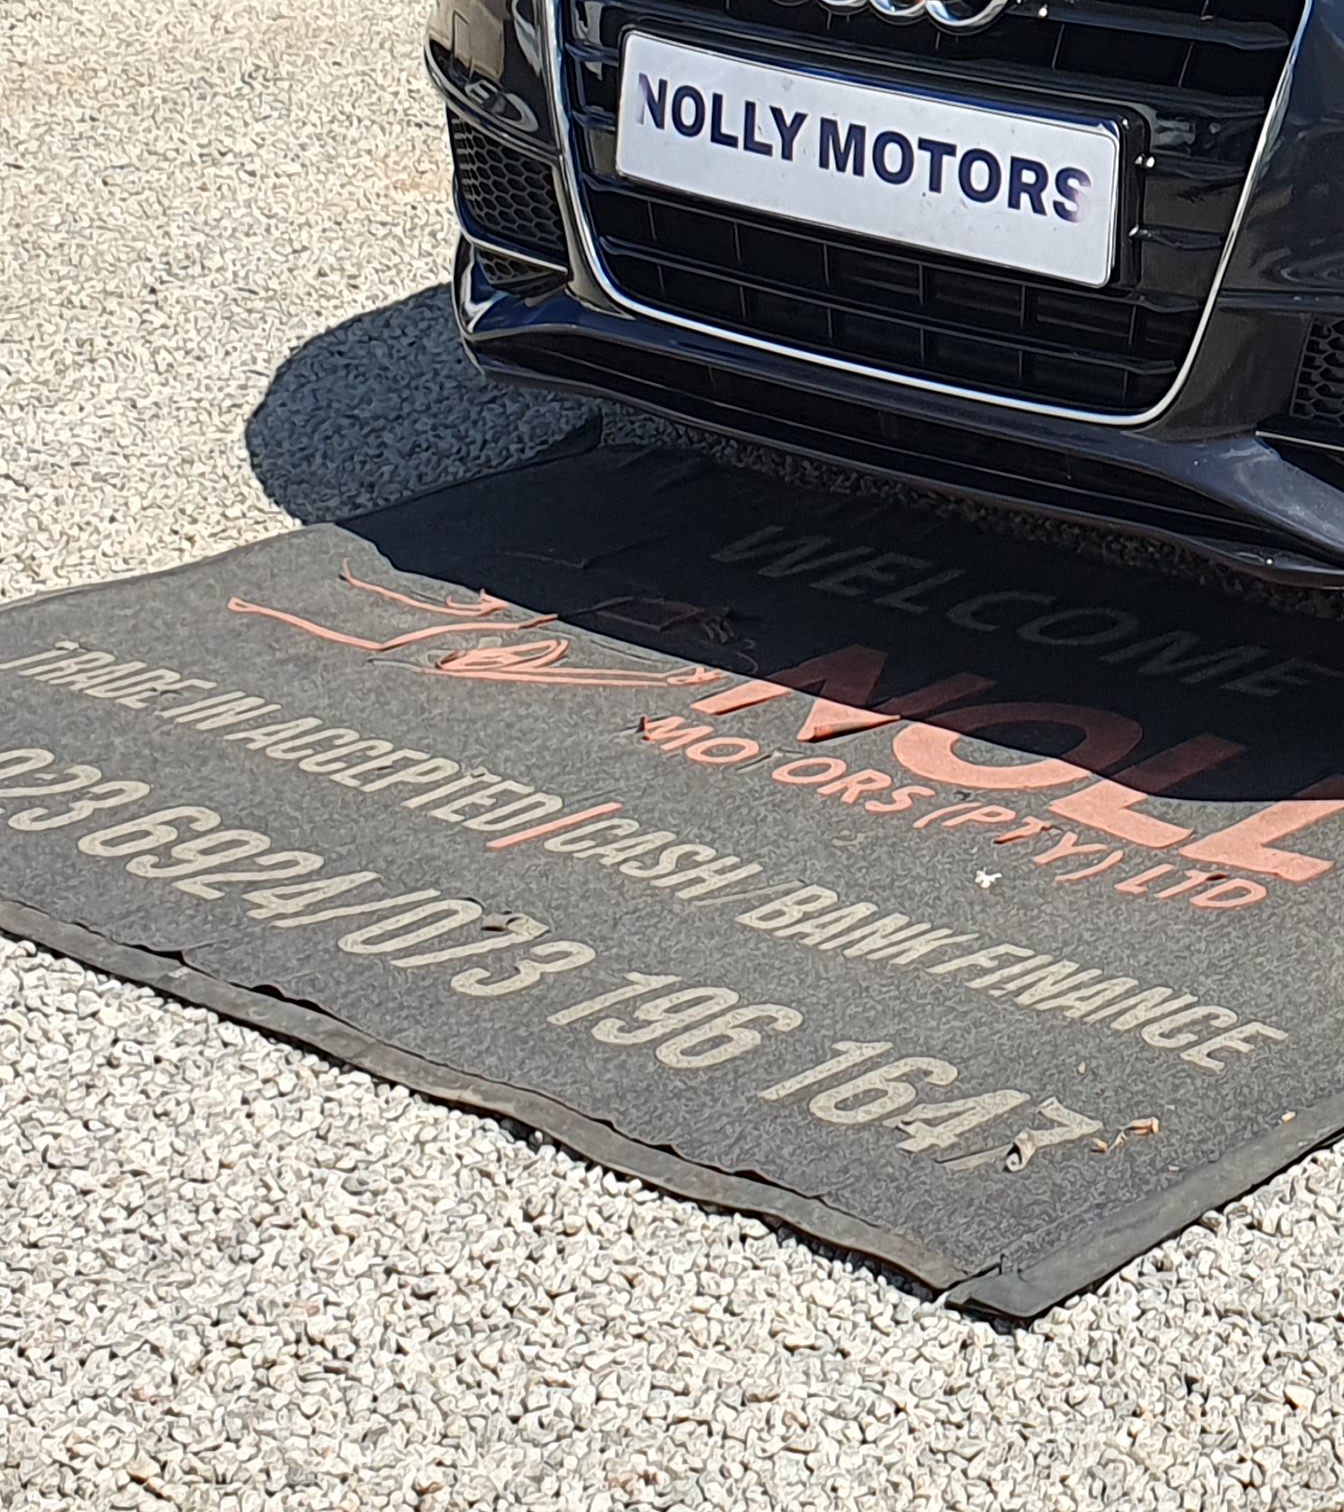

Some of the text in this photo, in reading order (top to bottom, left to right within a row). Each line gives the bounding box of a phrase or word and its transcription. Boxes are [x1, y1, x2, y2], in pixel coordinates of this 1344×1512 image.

[638, 73, 1093, 224] NOLLY MOTORS
[0, 640, 217, 709] TRADE
[153, 690, 282, 730] IN
[925, 942, 1290, 1075] FINANCE
[1113, 863, 1268, 909] LTD
[547, 971, 803, 1069] 196
[757, 1040, 1104, 1173] 1647
